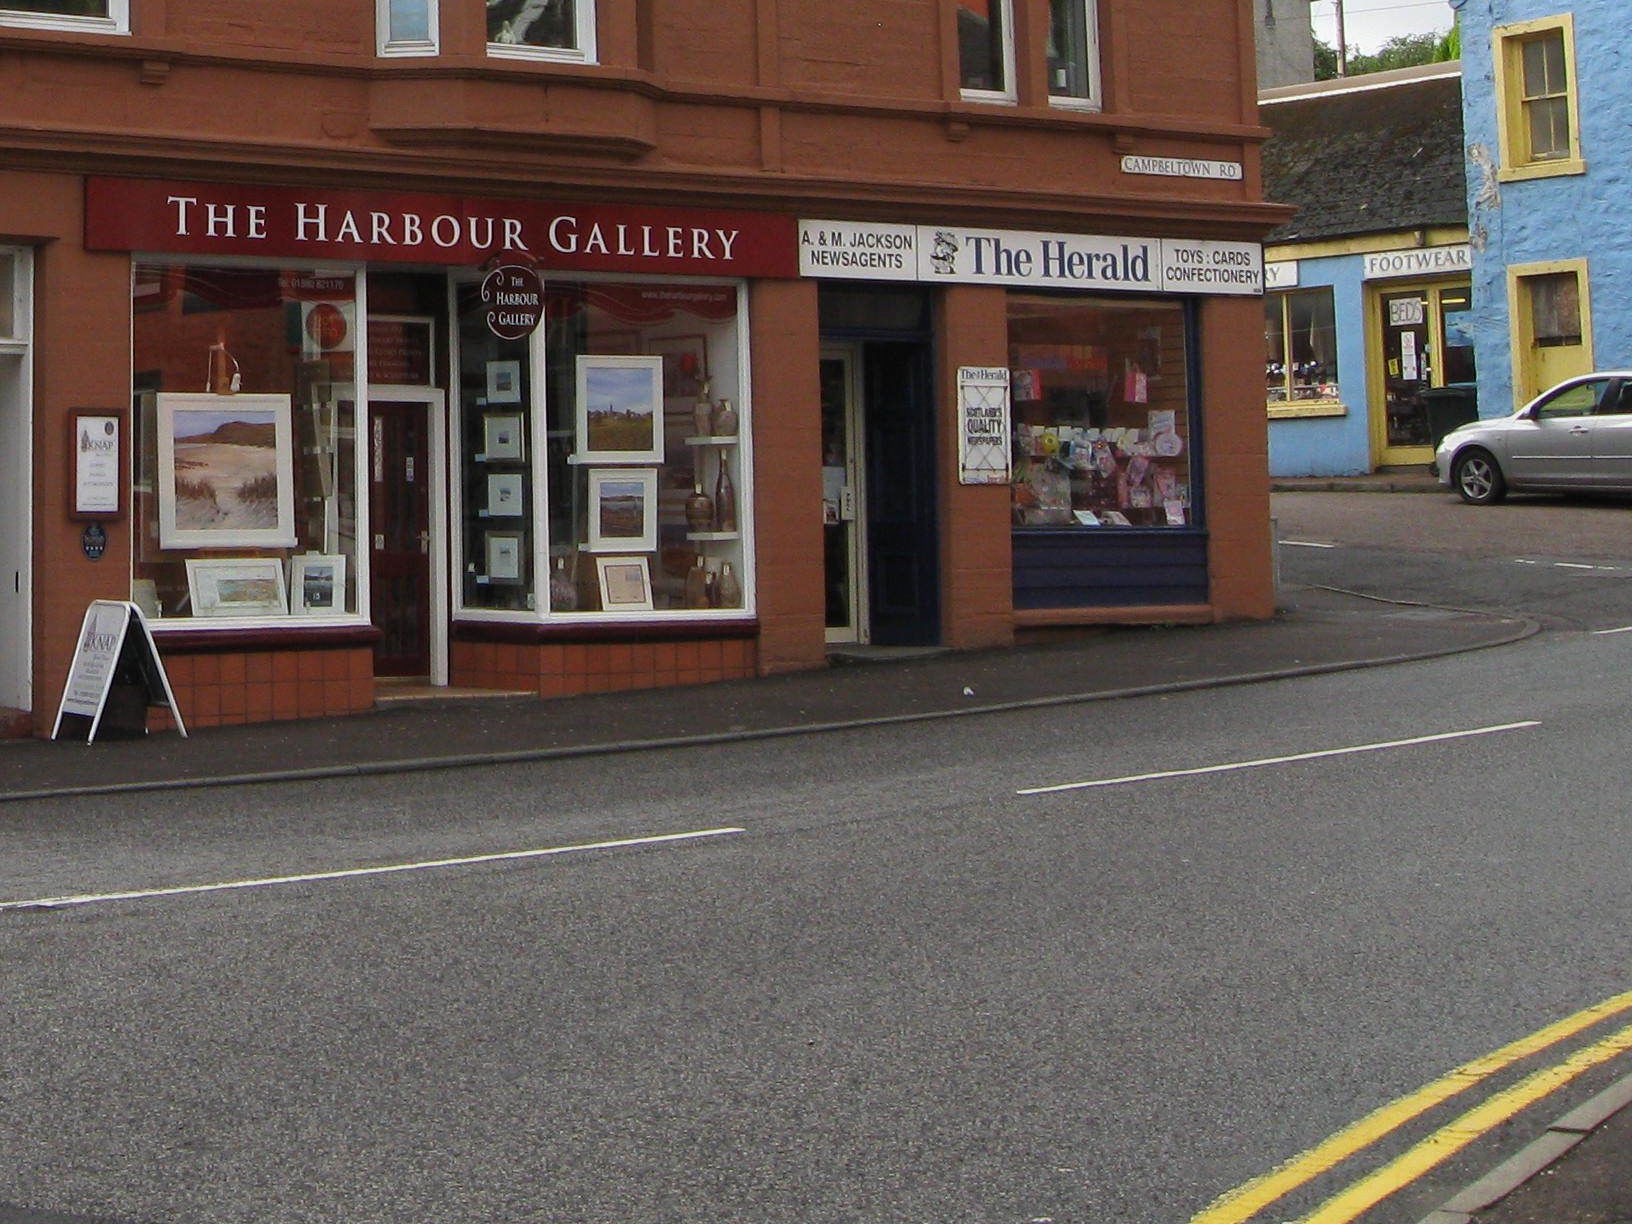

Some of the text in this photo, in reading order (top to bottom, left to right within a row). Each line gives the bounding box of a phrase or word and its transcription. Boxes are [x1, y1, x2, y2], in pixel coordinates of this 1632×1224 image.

[1124, 158, 1236, 178] CAMPBELTOWN RD
[167, 196, 739, 260] THE HARBOUR GALLERY
[801, 230, 912, 250] A. & M. JACKSON
[811, 250, 903, 269] NEWSAGENTS
[965, 236, 1152, 282] The Herald
[1174, 248, 1204, 264] TOYS
[1212, 250, 1251, 266] CARDS
[1370, 249, 1467, 273] FOOTWEAR
[511, 276, 524, 287] THE
[1166, 266, 1260, 284] CONFECTIONERY
[496, 291, 539, 306] HARBOUR
[498, 311, 536, 326] GALLERY
[1390, 299, 1422, 324] BEDS
[967, 418, 1002, 434] QUALITY
